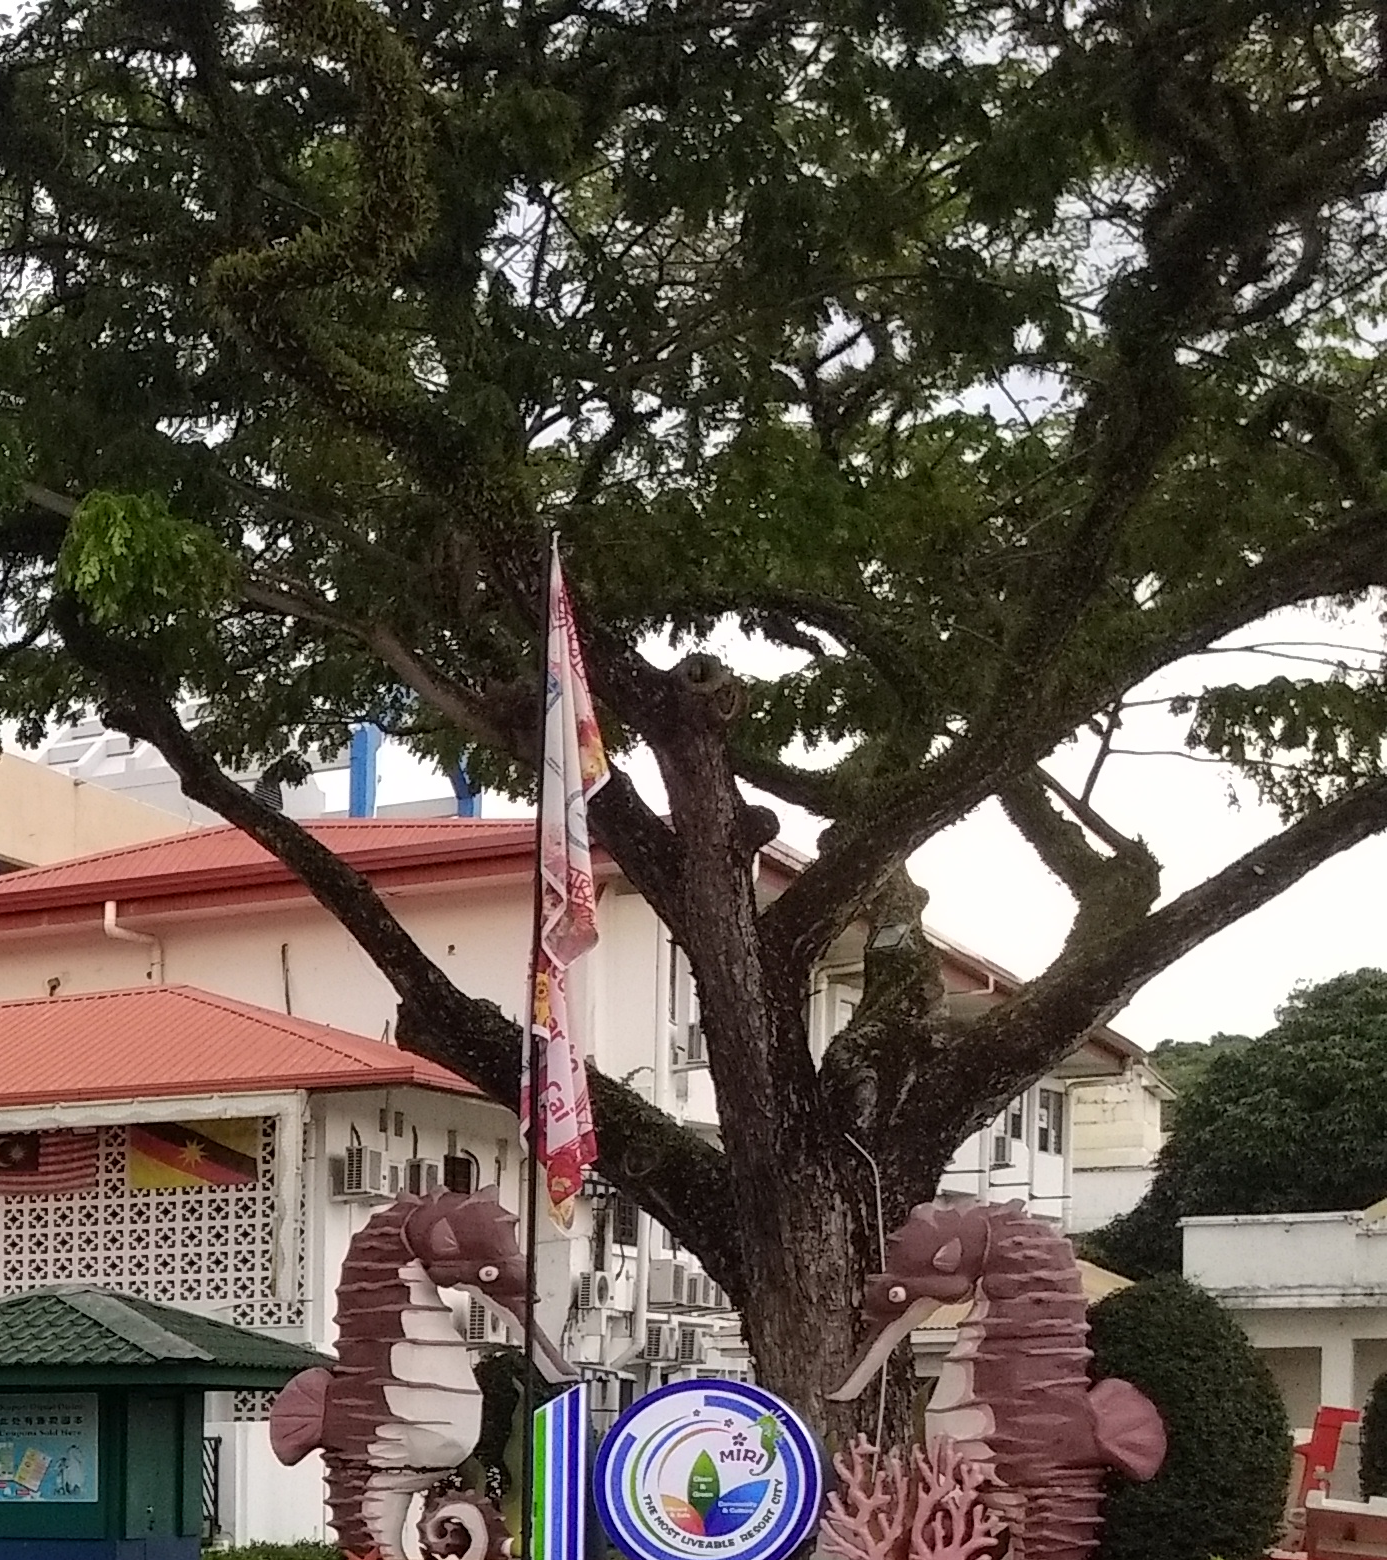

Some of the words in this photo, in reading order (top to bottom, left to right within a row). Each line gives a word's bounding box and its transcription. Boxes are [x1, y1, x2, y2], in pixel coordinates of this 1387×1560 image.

[0, 1429, 37, 1438] Coupons
[61, 1429, 82, 1437] Here
[719, 1447, 766, 1466] MIRI
[693, 1475, 714, 1483] Clean
[642, 1494, 661, 1518] THE
[654, 1516, 680, 1540] MOST
[681, 1534, 735, 1549] LIVEABLE
[740, 1507, 776, 1543] RESORT
[772, 1478, 784, 1506] CITY
